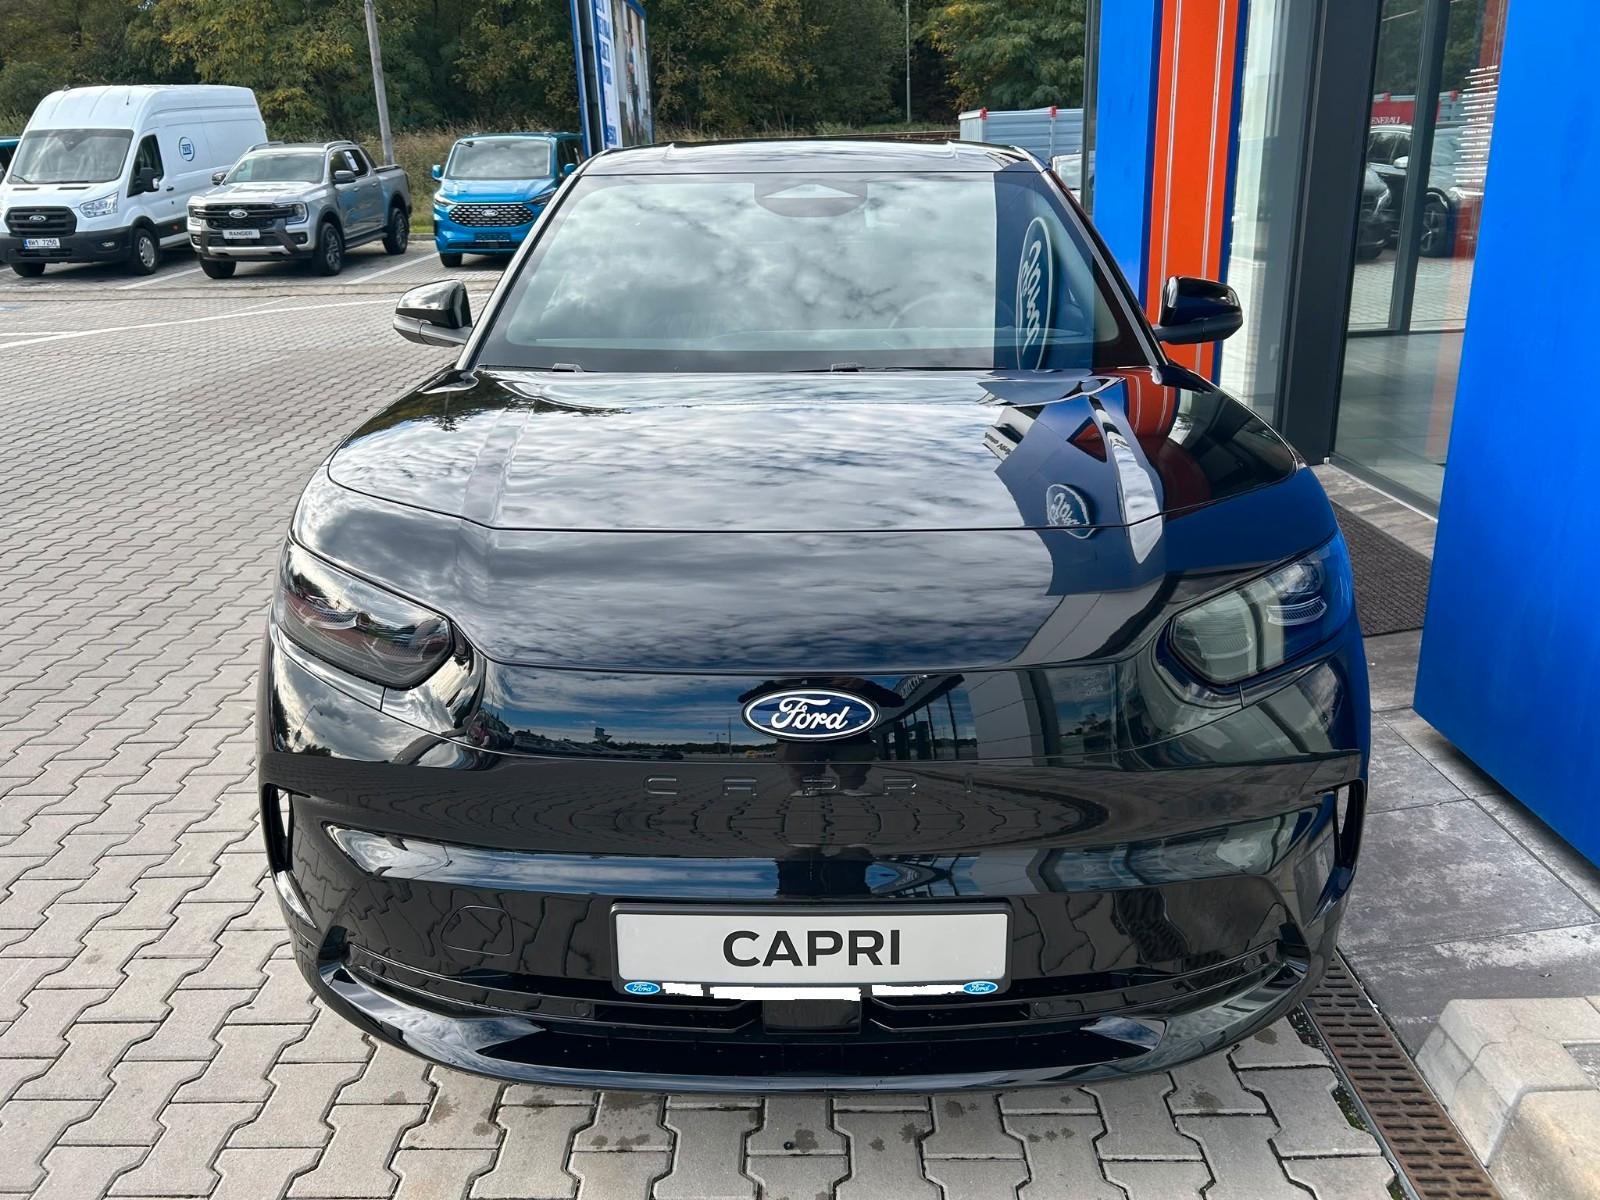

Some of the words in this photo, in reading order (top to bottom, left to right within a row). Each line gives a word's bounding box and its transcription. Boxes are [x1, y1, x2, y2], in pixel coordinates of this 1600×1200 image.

[771, 697, 850, 729] Ford
[643, 774, 974, 796] CAPRI
[723, 930, 900, 967] CAPRI
